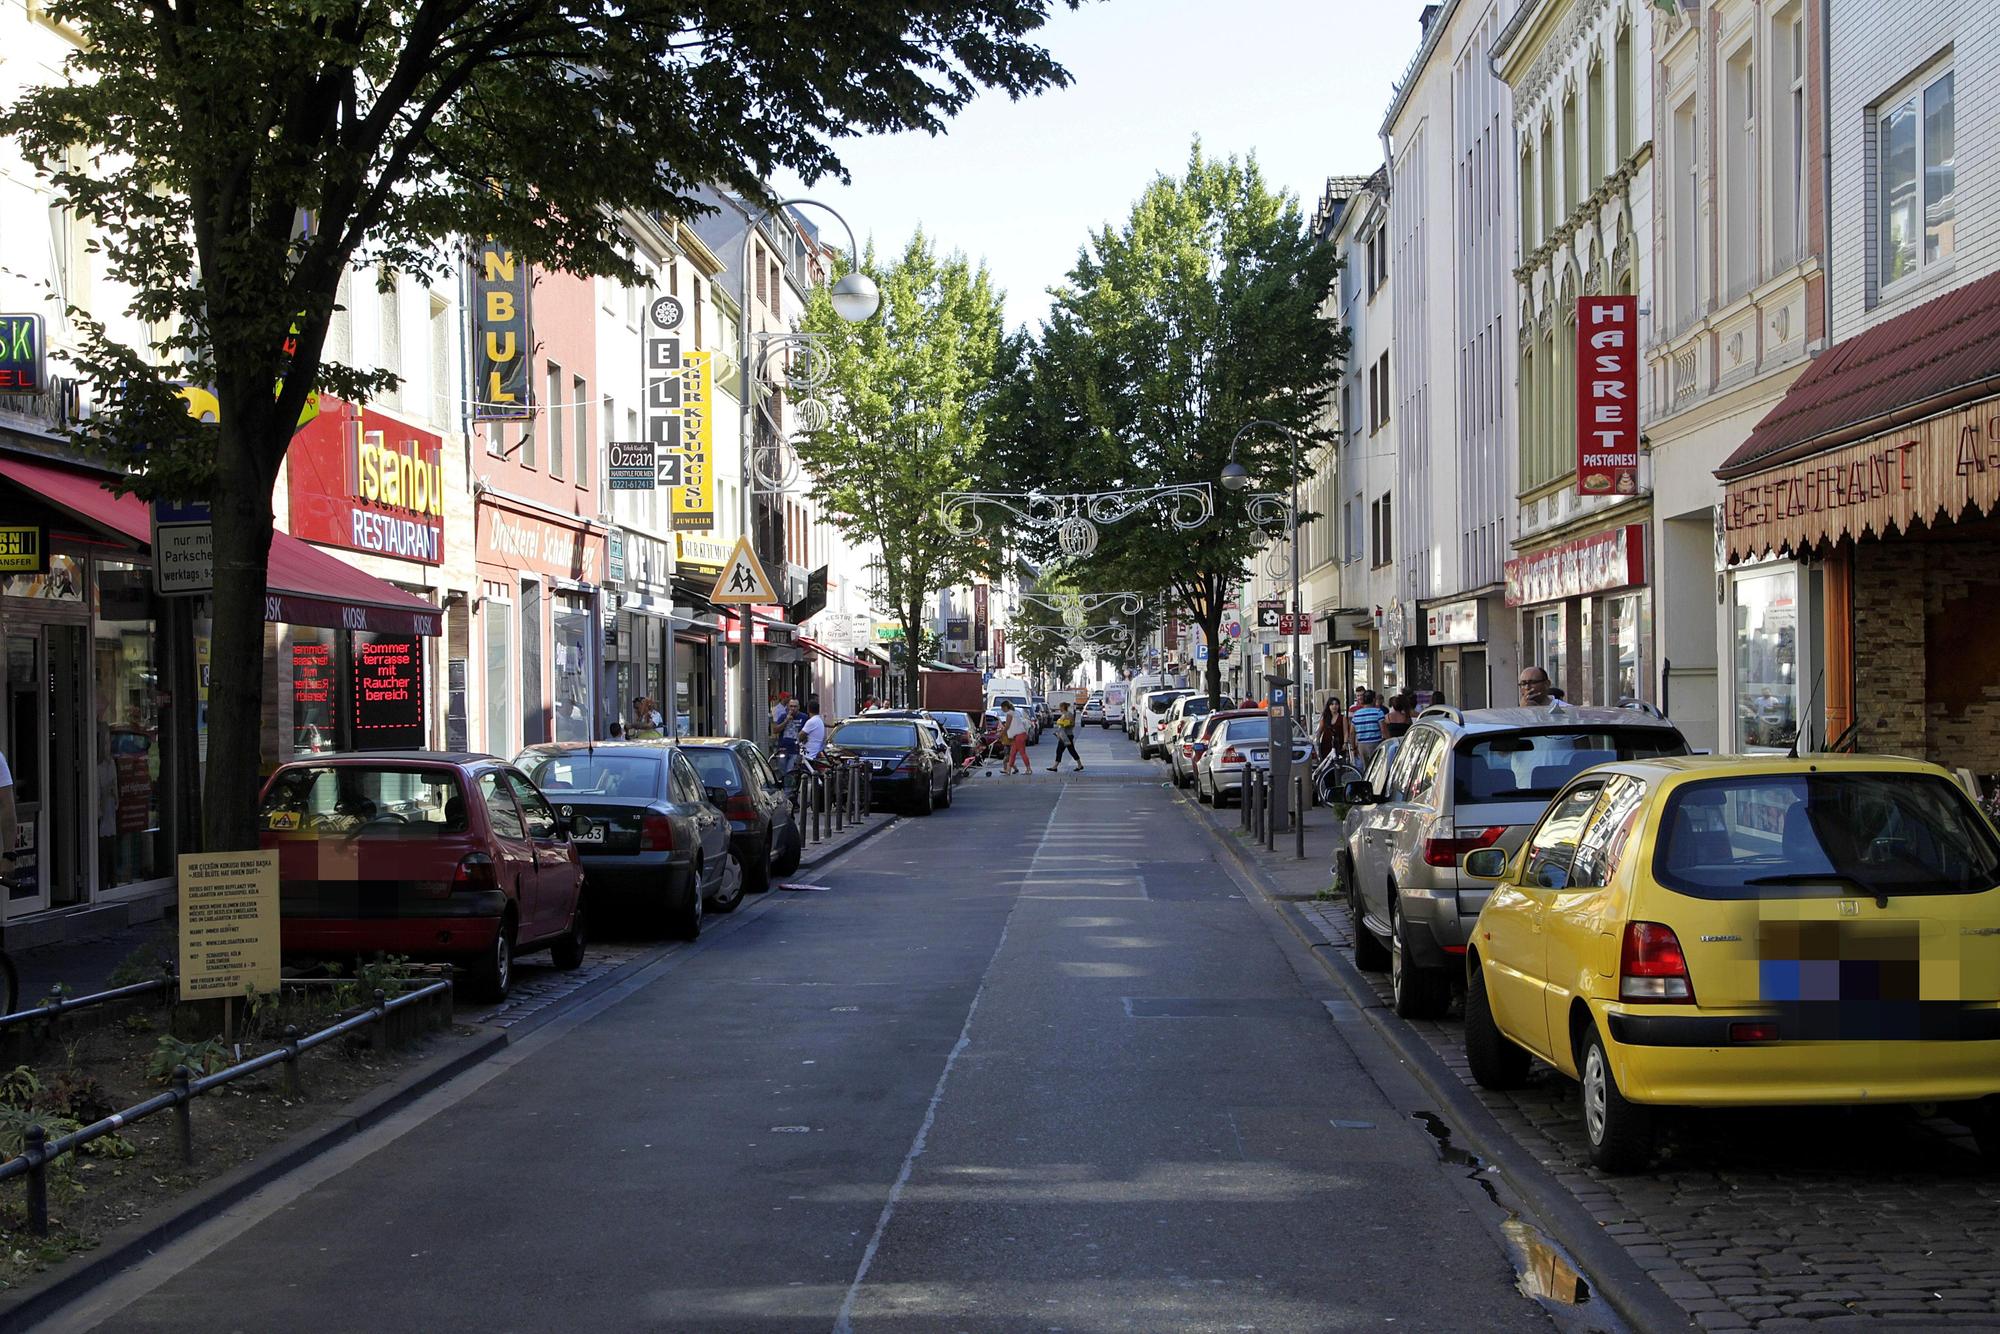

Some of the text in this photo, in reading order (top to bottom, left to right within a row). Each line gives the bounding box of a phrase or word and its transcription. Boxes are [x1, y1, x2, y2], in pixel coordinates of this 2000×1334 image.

[484, 251, 516, 402] NBUL
[1591, 305, 1627, 448] HASRET
[657, 343, 674, 481] ELIZ
[610, 443, 654, 466] Özcan
[1583, 453, 1637, 468] PASTANESI
[612, 480, 654, 488] 0221-612413
[1725, 441, 1919, 532] RESTAURANT
[675, 517, 711, 525] JUWELIER
[174, 536, 190, 546] nur
[352, 508, 440, 561] RESTAURANT
[342, 607, 367, 629] KIOSK
[413, 614, 433, 636] KIOSK
[362, 642, 410, 654] Sommer
[363, 654, 410, 665] terrasse
[378, 666, 397, 676] mit
[363, 676, 410, 689] Raucher
[366, 688, 408, 701] bereich
[1275, 690, 1282, 702] P
